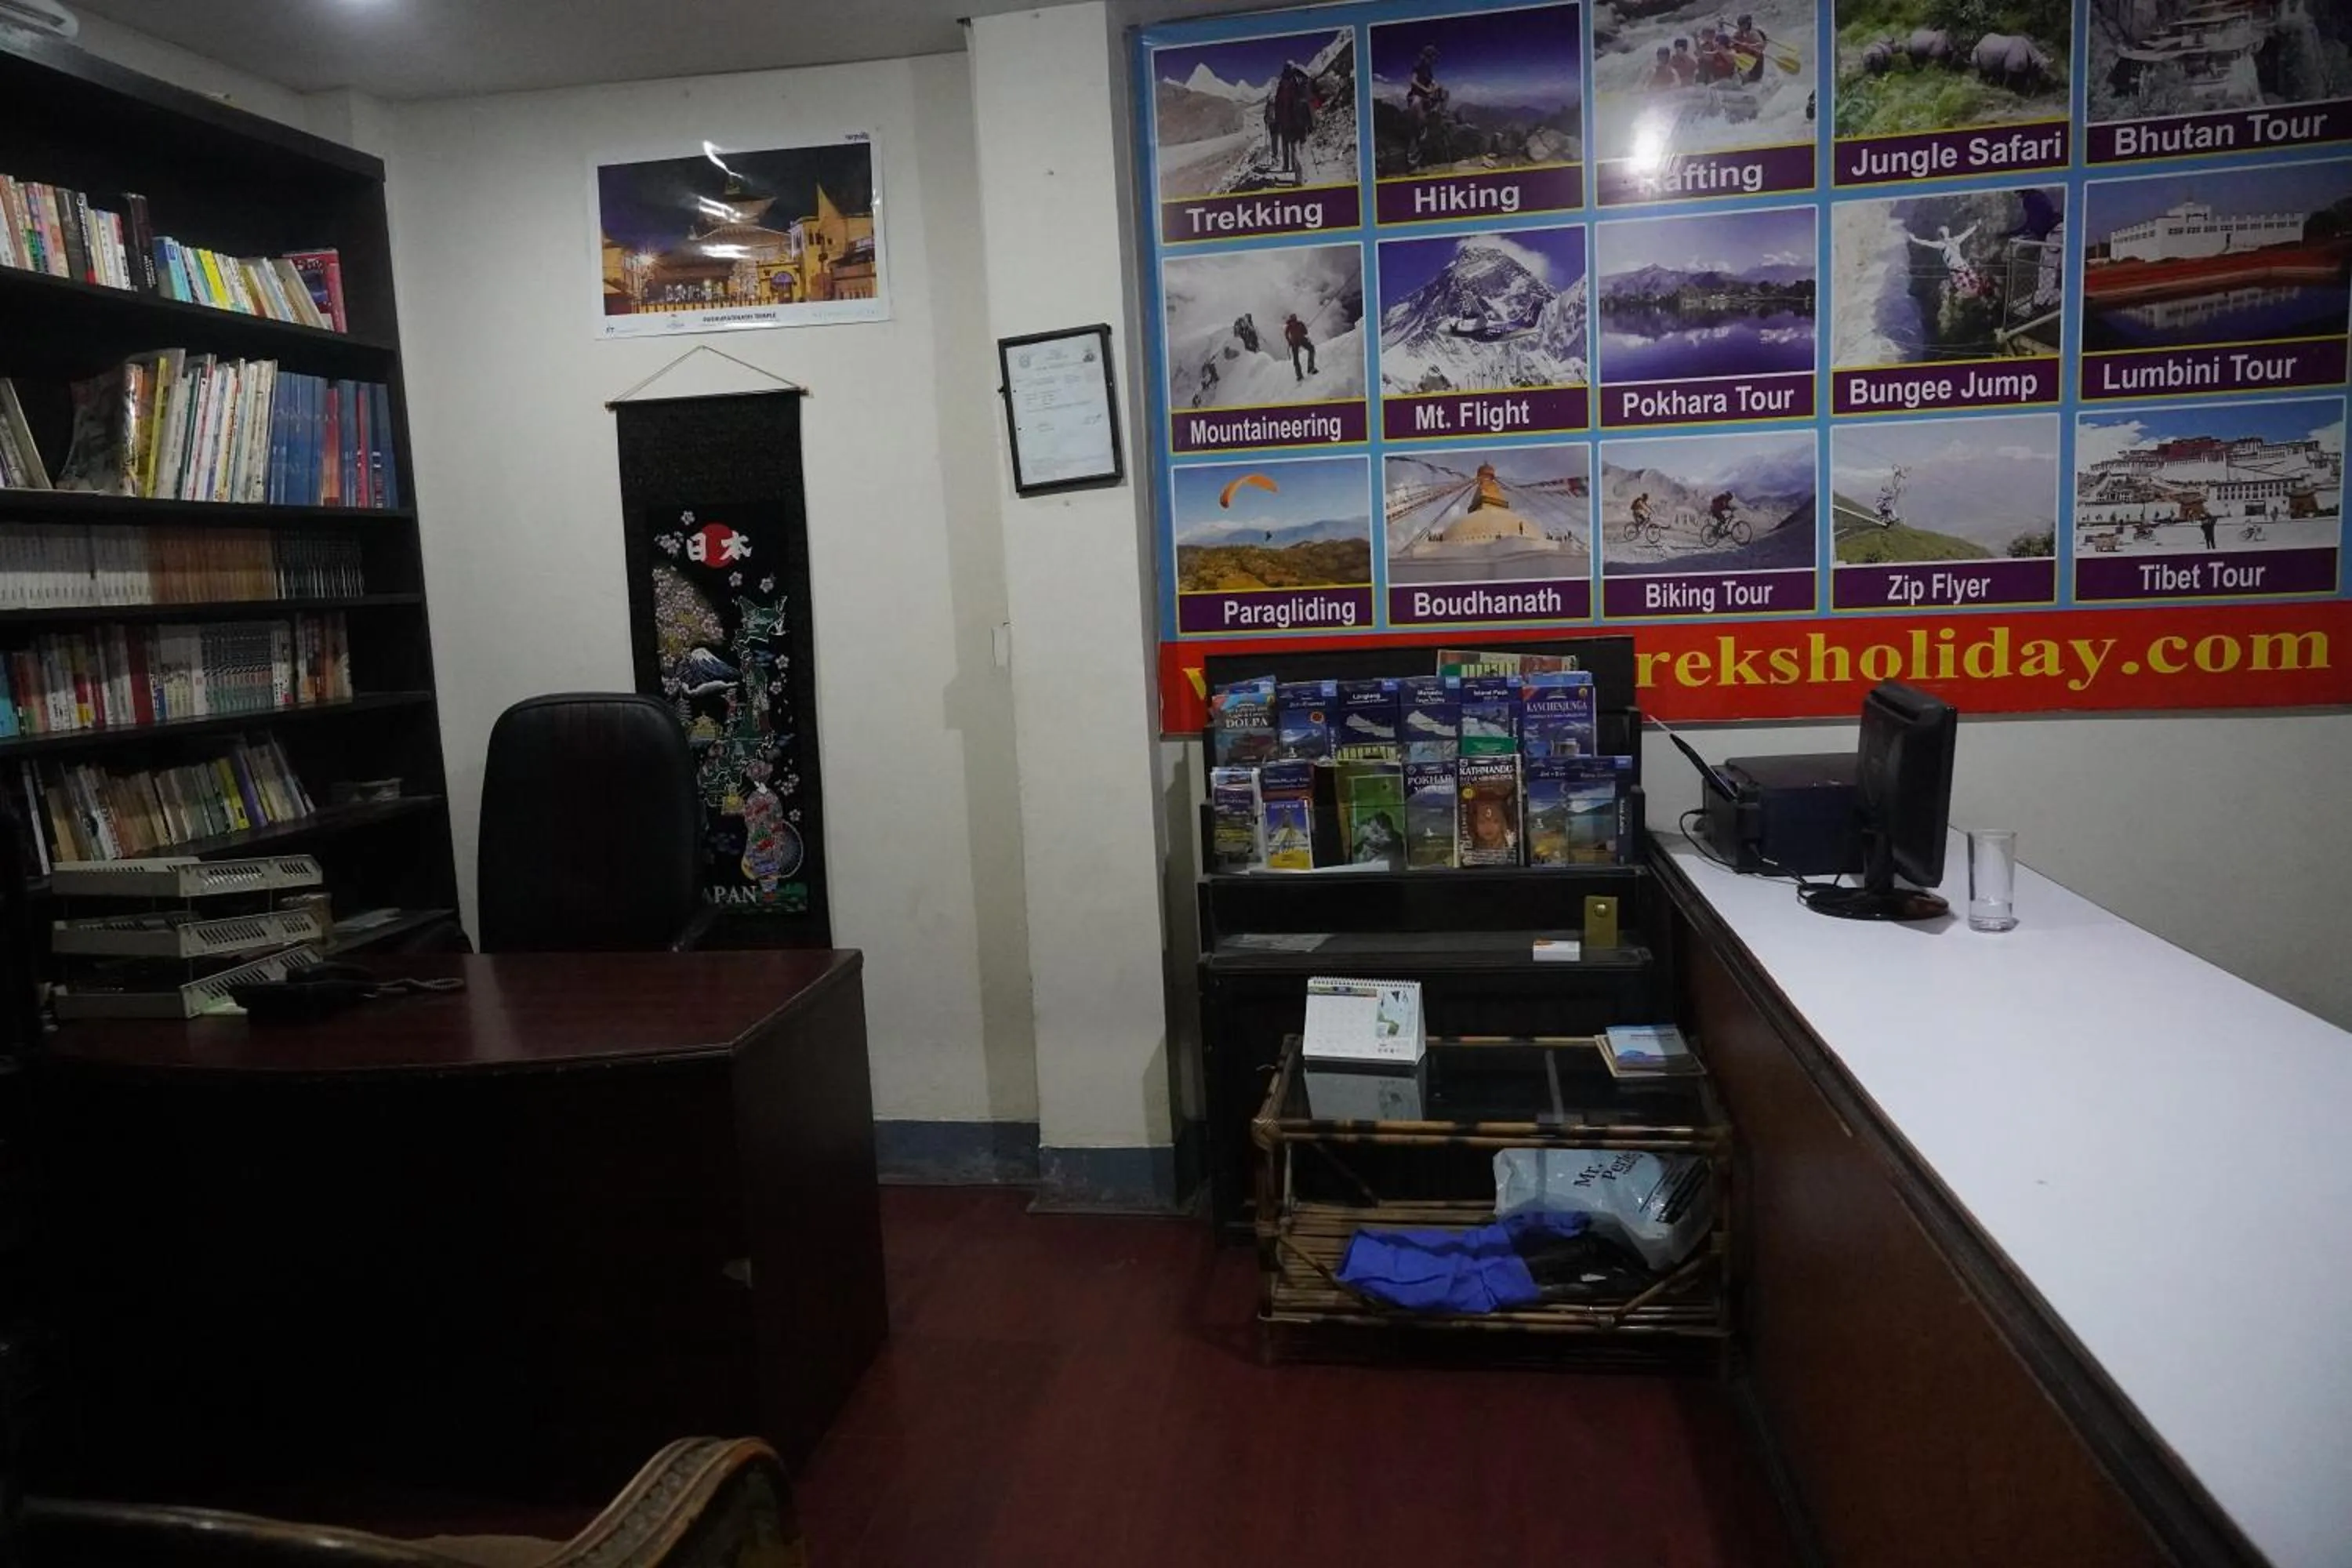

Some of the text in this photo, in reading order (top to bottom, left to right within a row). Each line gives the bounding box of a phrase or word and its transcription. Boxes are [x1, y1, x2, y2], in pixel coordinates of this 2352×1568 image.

[2114, 112, 2328, 156] Bhutan Tour
[1851, 130, 2062, 179] Jungle Safari
[1414, 184, 1521, 213] Hiking
[1185, 201, 1323, 234] Trekking
[2103, 354, 2298, 390] Lumbini Tour
[1623, 386, 1794, 418] Pokhara Tour
[1849, 370, 2038, 409] Bungee Jump
[1190, 415, 1342, 445] Mountaineering
[1415, 400, 1530, 431] Mt. Flight
[686, 530, 753, 562] 日本
[1887, 572, 1991, 606] Zip Flyer
[2139, 561, 2266, 591] Tibet Tour
[1413, 588, 1562, 617] Boudhanath
[1645, 580, 1773, 612] Biking Tour
[1223, 598, 1356, 628] Paragliding
[702, 884, 757, 905] APAN
[1573, 1163, 1603, 1187] Mr.
